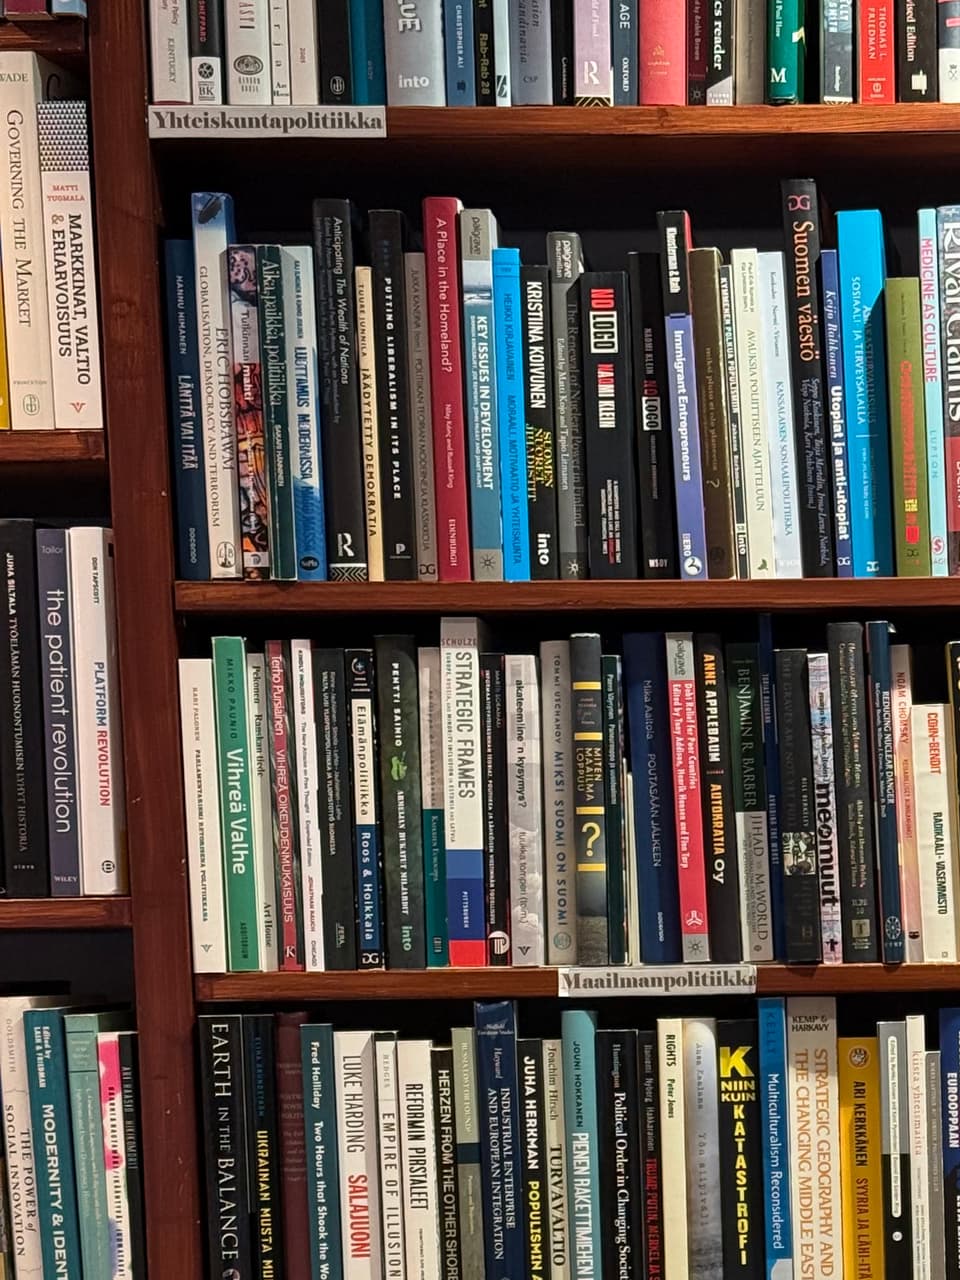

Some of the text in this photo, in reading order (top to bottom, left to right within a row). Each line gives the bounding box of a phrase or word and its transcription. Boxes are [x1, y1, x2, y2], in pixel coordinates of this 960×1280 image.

[153, 110, 383, 132] Yhteiskuntapolitiikka
[398, 75, 430, 88] into
[52, 215, 72, 357] & ERIARVOISUUS
[436, 218, 452, 373] A Place in the Homeland?
[590, 288, 615, 350] NO LOGO
[793, 221, 820, 362] Suomen väestö
[76, 326, 91, 385] VALTIO
[526, 282, 546, 409] KRISTINA KOIVUNEN
[537, 533, 549, 565] into
[44, 588, 72, 834] the patient revolution
[455, 652, 476, 799] STRATEGIC FRAMES
[704, 654, 720, 762] ANNE APPLEBAUM
[226, 748, 248, 875] Vihreä Valhe
[357, 706, 369, 817] Elämänpolitiikka
[710, 784, 726, 884] AUTOKRATIA OY
[524, 1056, 535, 1089] JUHA
[719, 1046, 755, 1078] K
[721, 1081, 755, 1090] NIIN
[721, 1092, 756, 1102] KUIN
[211, 1024, 238, 1260] EARTH IN THE BALANCE
[342, 1055, 371, 1259] LUKE HARDING SALAJUONI
[525, 1093, 539, 1170] HERMAN
[528, 1180, 542, 1270] POPULISMIN
[733, 1104, 748, 1265] KATASTROFI
